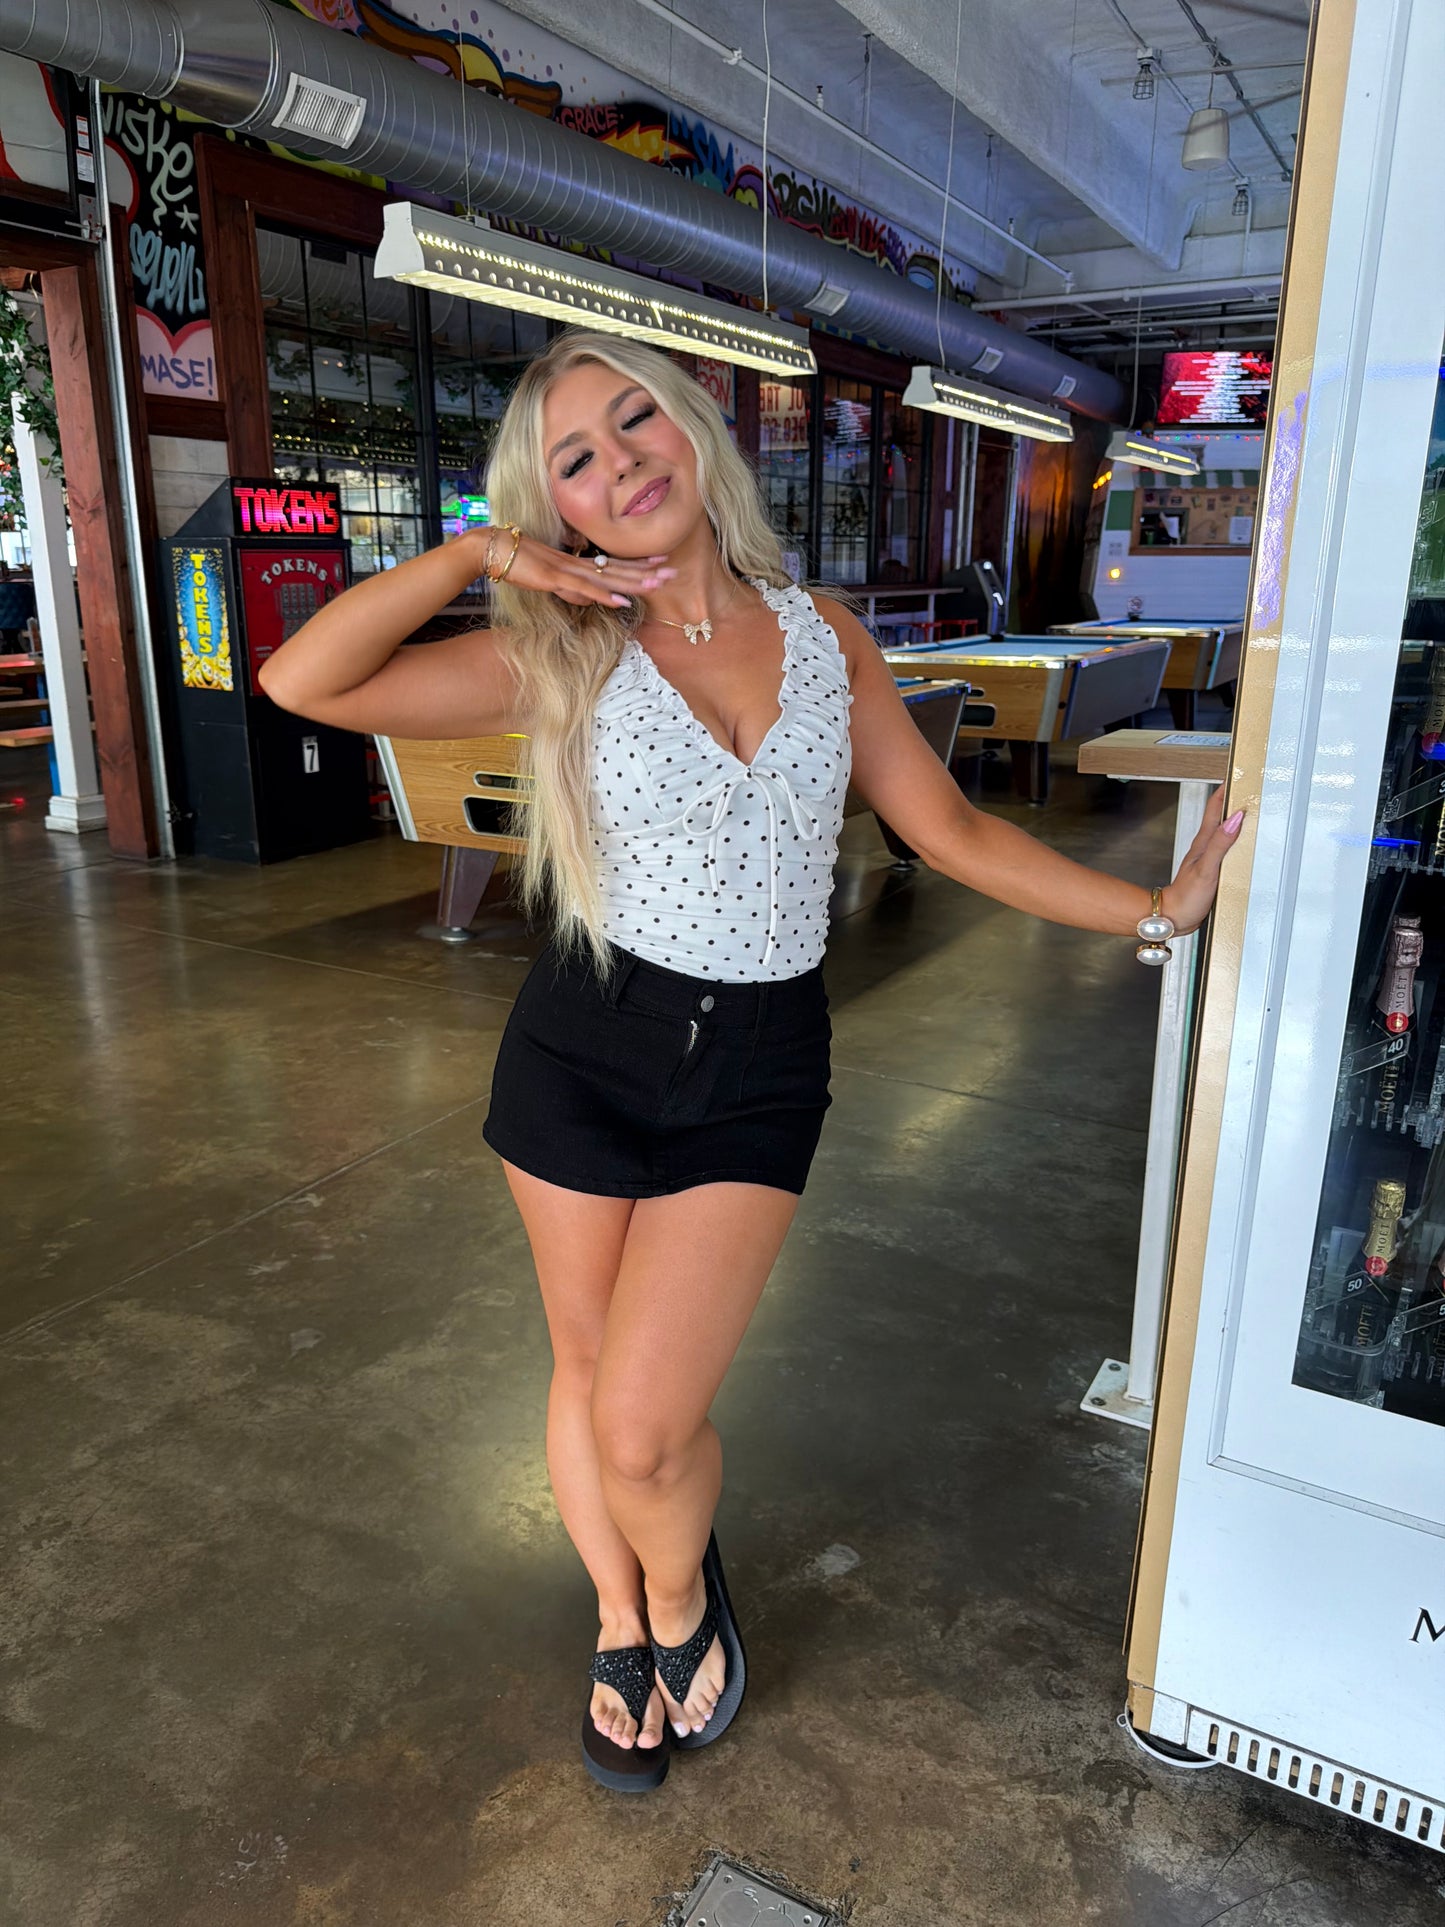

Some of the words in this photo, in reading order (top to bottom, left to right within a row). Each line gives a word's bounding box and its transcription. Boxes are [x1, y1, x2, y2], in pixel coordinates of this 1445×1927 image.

[233, 487, 339, 533] TOKENS
[261, 558, 328, 584] TOKENS
[190, 553, 213, 654] TOKENS
[1388, 1038, 1403, 1054] 40
[1347, 1278, 1363, 1292] 50
